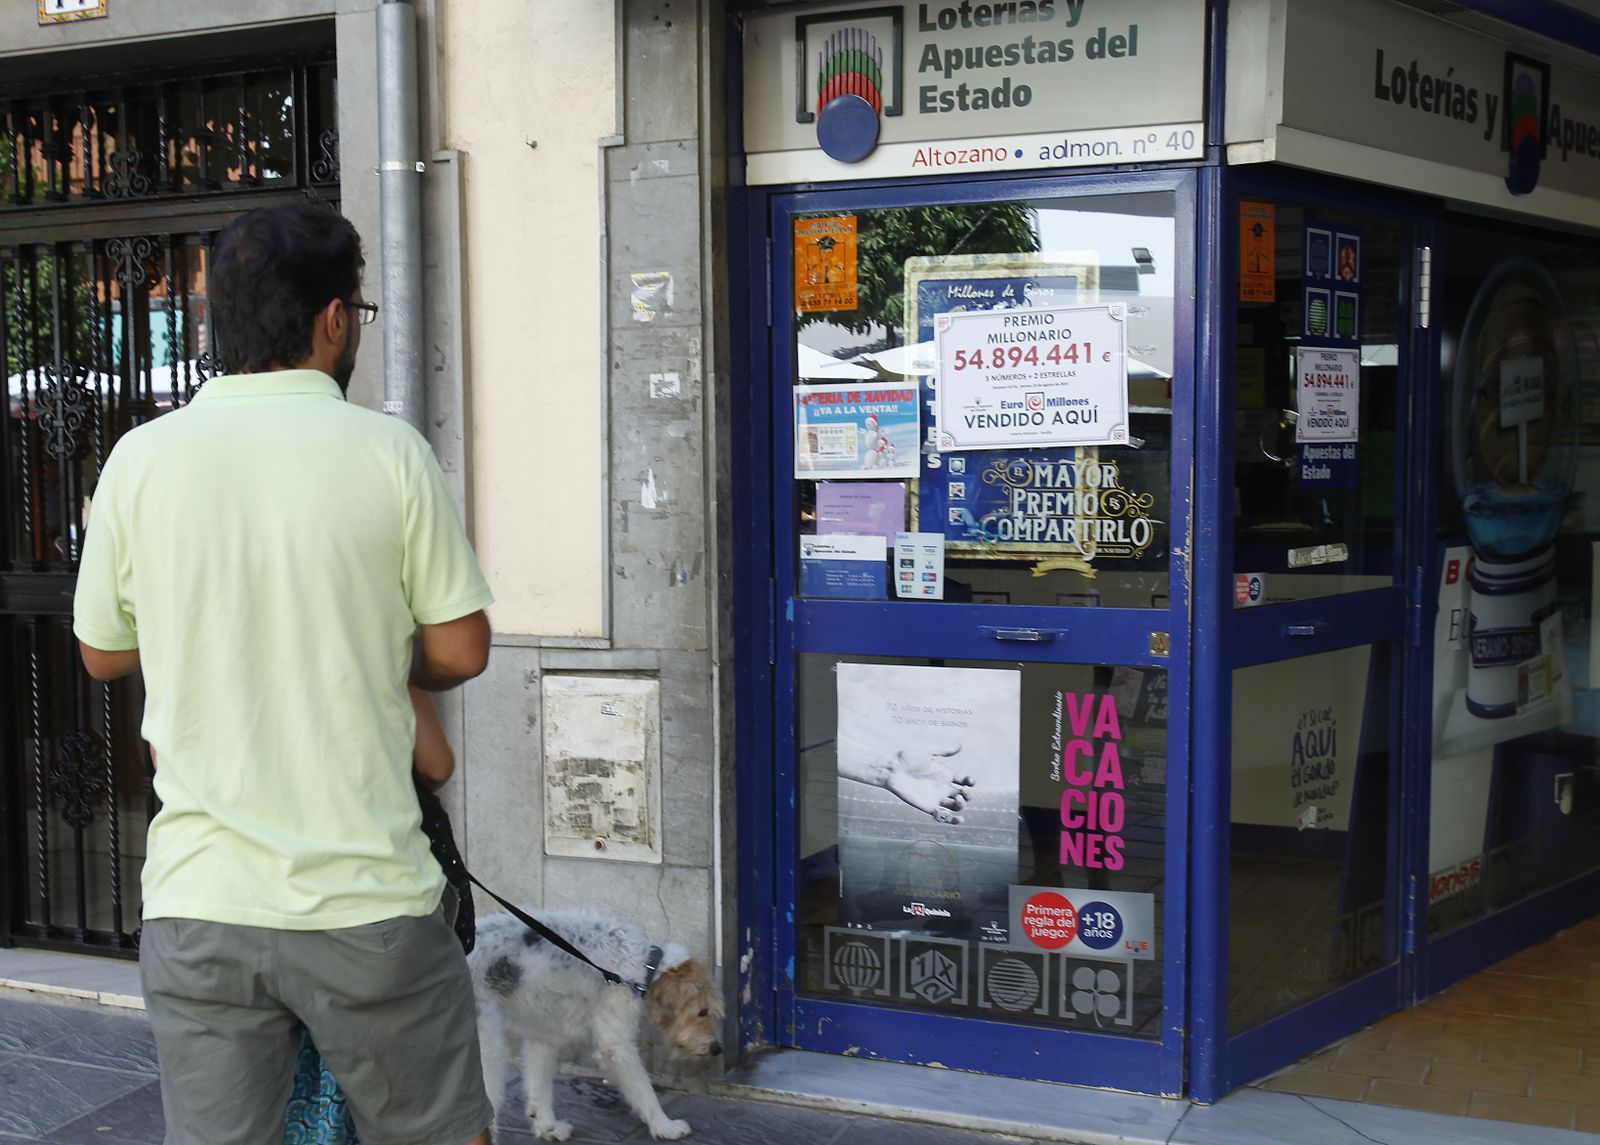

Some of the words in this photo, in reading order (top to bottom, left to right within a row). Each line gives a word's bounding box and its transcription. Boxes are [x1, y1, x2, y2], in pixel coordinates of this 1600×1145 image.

[1066, 0, 1085, 28] y
[918, 35, 1074, 79] Apuestas
[1085, 24, 1138, 60] del
[919, 77, 1032, 114] Estado
[1374, 48, 1479, 124] Loterías
[1484, 92, 1498, 141] y
[1549, 104, 1600, 162] Apue
[912, 144, 1007, 168] Altozano
[1039, 138, 1122, 161] admon.
[1166, 130, 1195, 151] 40
[947, 284, 996, 299] Millones
[1002, 284, 1015, 297] de
[1003, 314, 1055, 328] PREMIO
[987, 328, 1072, 344] MILLONARIO
[953, 342, 1092, 371] 54.894.441
[1102, 351, 1111, 363] €
[991, 372, 1027, 382] NÚMEROS
[1033, 372, 1039, 380] 2
[1039, 370, 1077, 379] ESTRELLAS
[848, 391, 861, 403] DE
[864, 389, 914, 403] NAVIDAD
[1000, 401, 1024, 410] Euro
[1046, 397, 1089, 407] Millones
[834, 406, 843, 415] A
[844, 405, 857, 414] LA
[964, 411, 1045, 429] VENDIDO
[1051, 405, 1098, 426] AQUÍ
[1302, 444, 1342, 464] Apuestas
[1342, 444, 1355, 460] del
[1013, 467, 1024, 477] EL
[1033, 460, 1120, 489] MAYOR
[1302, 464, 1332, 480] Estado
[1012, 487, 1099, 517] PREMIO
[980, 516, 1151, 547] COMPARTIRLO
[940, 720, 968, 728] SIGNOS
[1064, 692, 1122, 740] VA
[1291, 720, 1337, 766] AQUÍ
[1063, 739, 1125, 789] CA
[1060, 788, 1126, 833] CIO
[1059, 831, 1126, 871] NES
[1023, 915, 1055, 929] regla
[1056, 916, 1076, 928] del
[1026, 904, 1073, 917] Primera
[1081, 912, 1116, 930] +18
[1083, 928, 1114, 939] años
